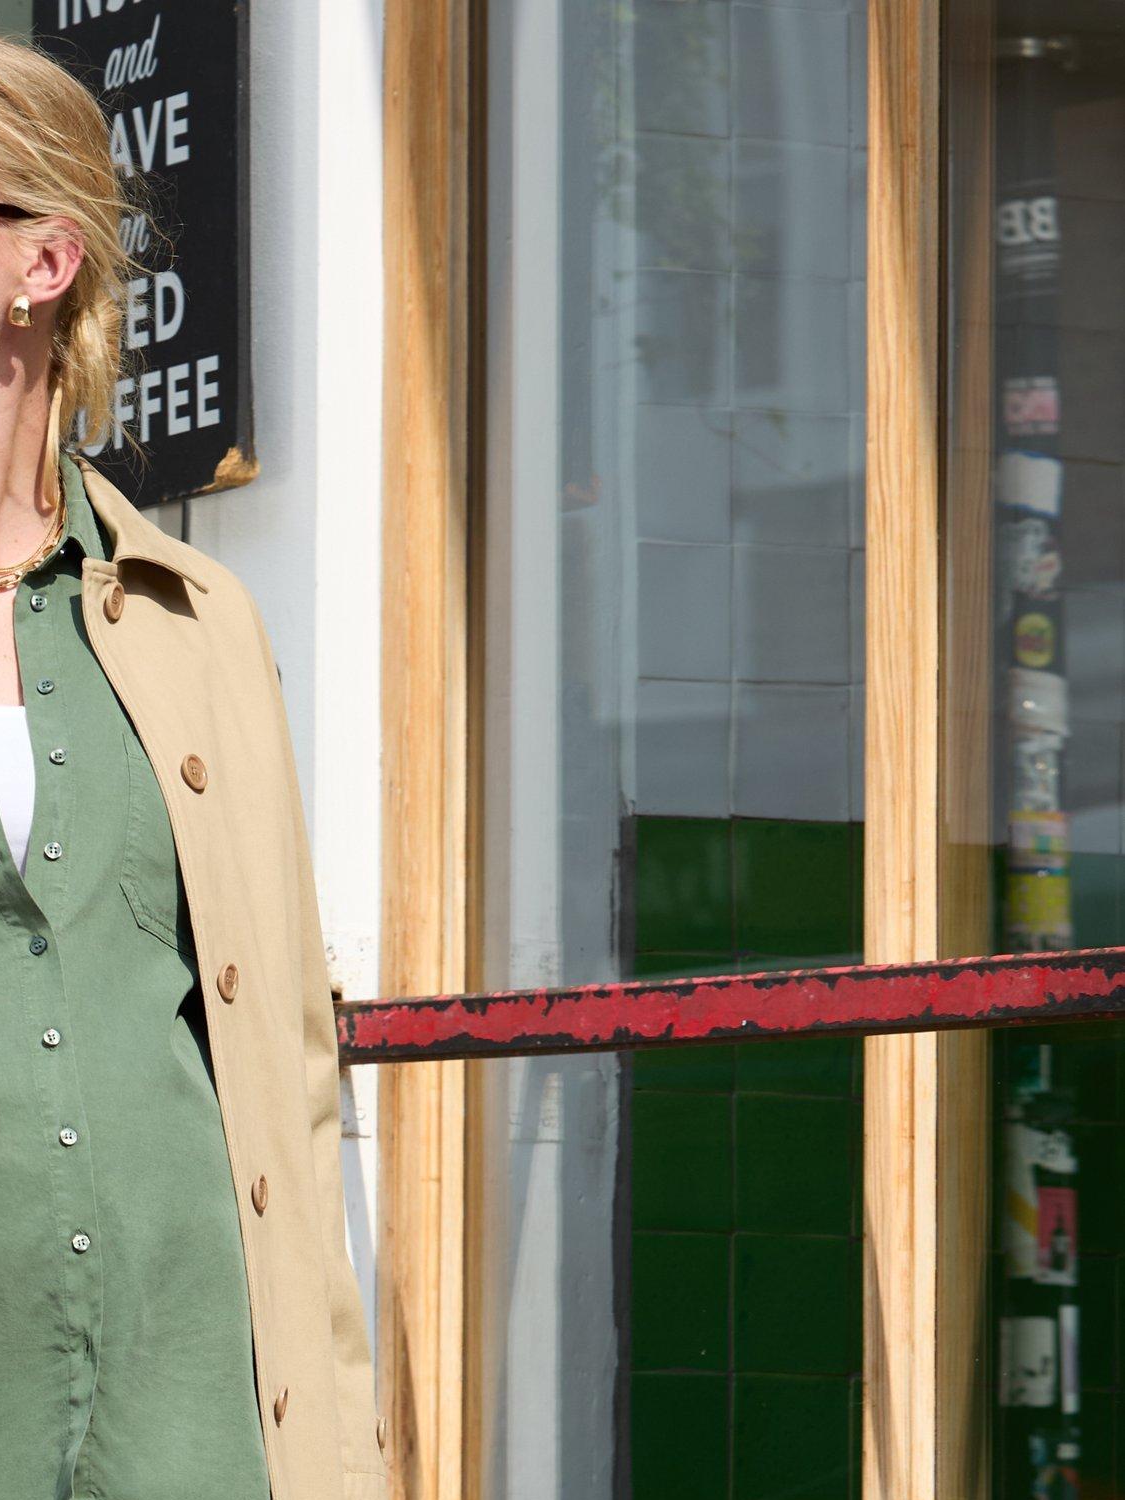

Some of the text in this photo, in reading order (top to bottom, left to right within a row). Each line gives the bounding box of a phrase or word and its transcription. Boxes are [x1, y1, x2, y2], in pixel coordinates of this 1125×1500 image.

[105, 13, 161, 91] and
[110, 91, 190, 178] AVE
[125, 270, 185, 351] ED
[78, 355, 221, 458] FFEE
